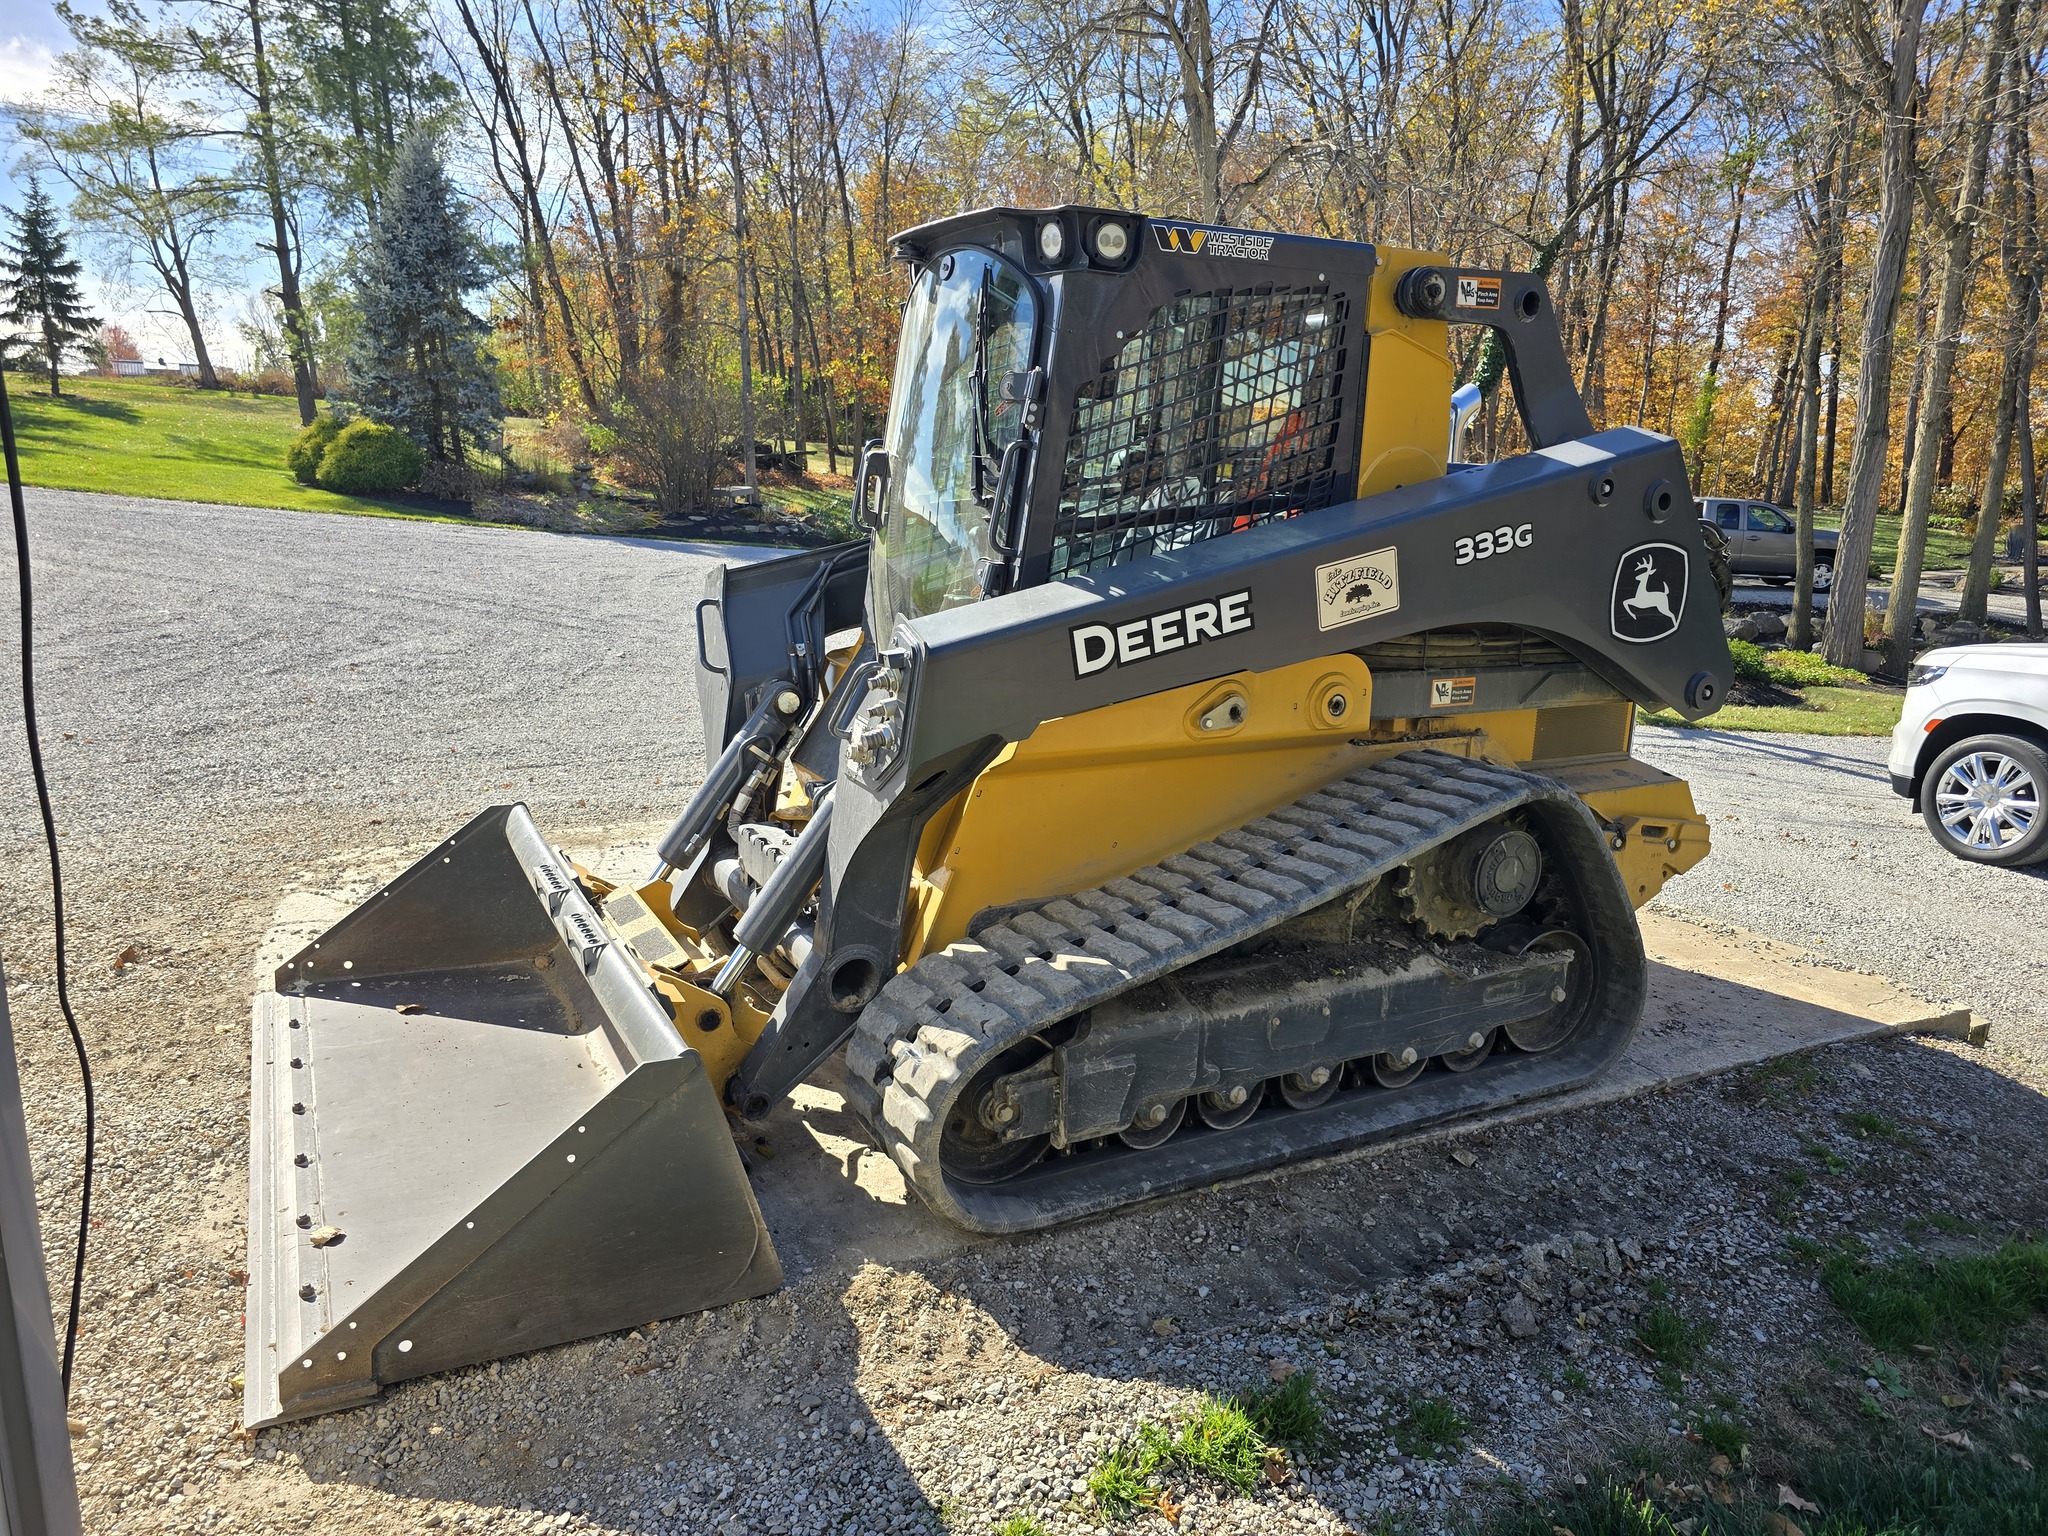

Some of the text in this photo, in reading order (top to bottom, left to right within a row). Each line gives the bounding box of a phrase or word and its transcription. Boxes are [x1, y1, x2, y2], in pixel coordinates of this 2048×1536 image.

[1207, 243, 1269, 261] TRACTOR
[1208, 231, 1274, 248] WEST SIDE
[1455, 523, 1533, 565] 333G
[1324, 567, 1393, 605] HITZFIELD
[1072, 591, 1252, 676] DEERE
